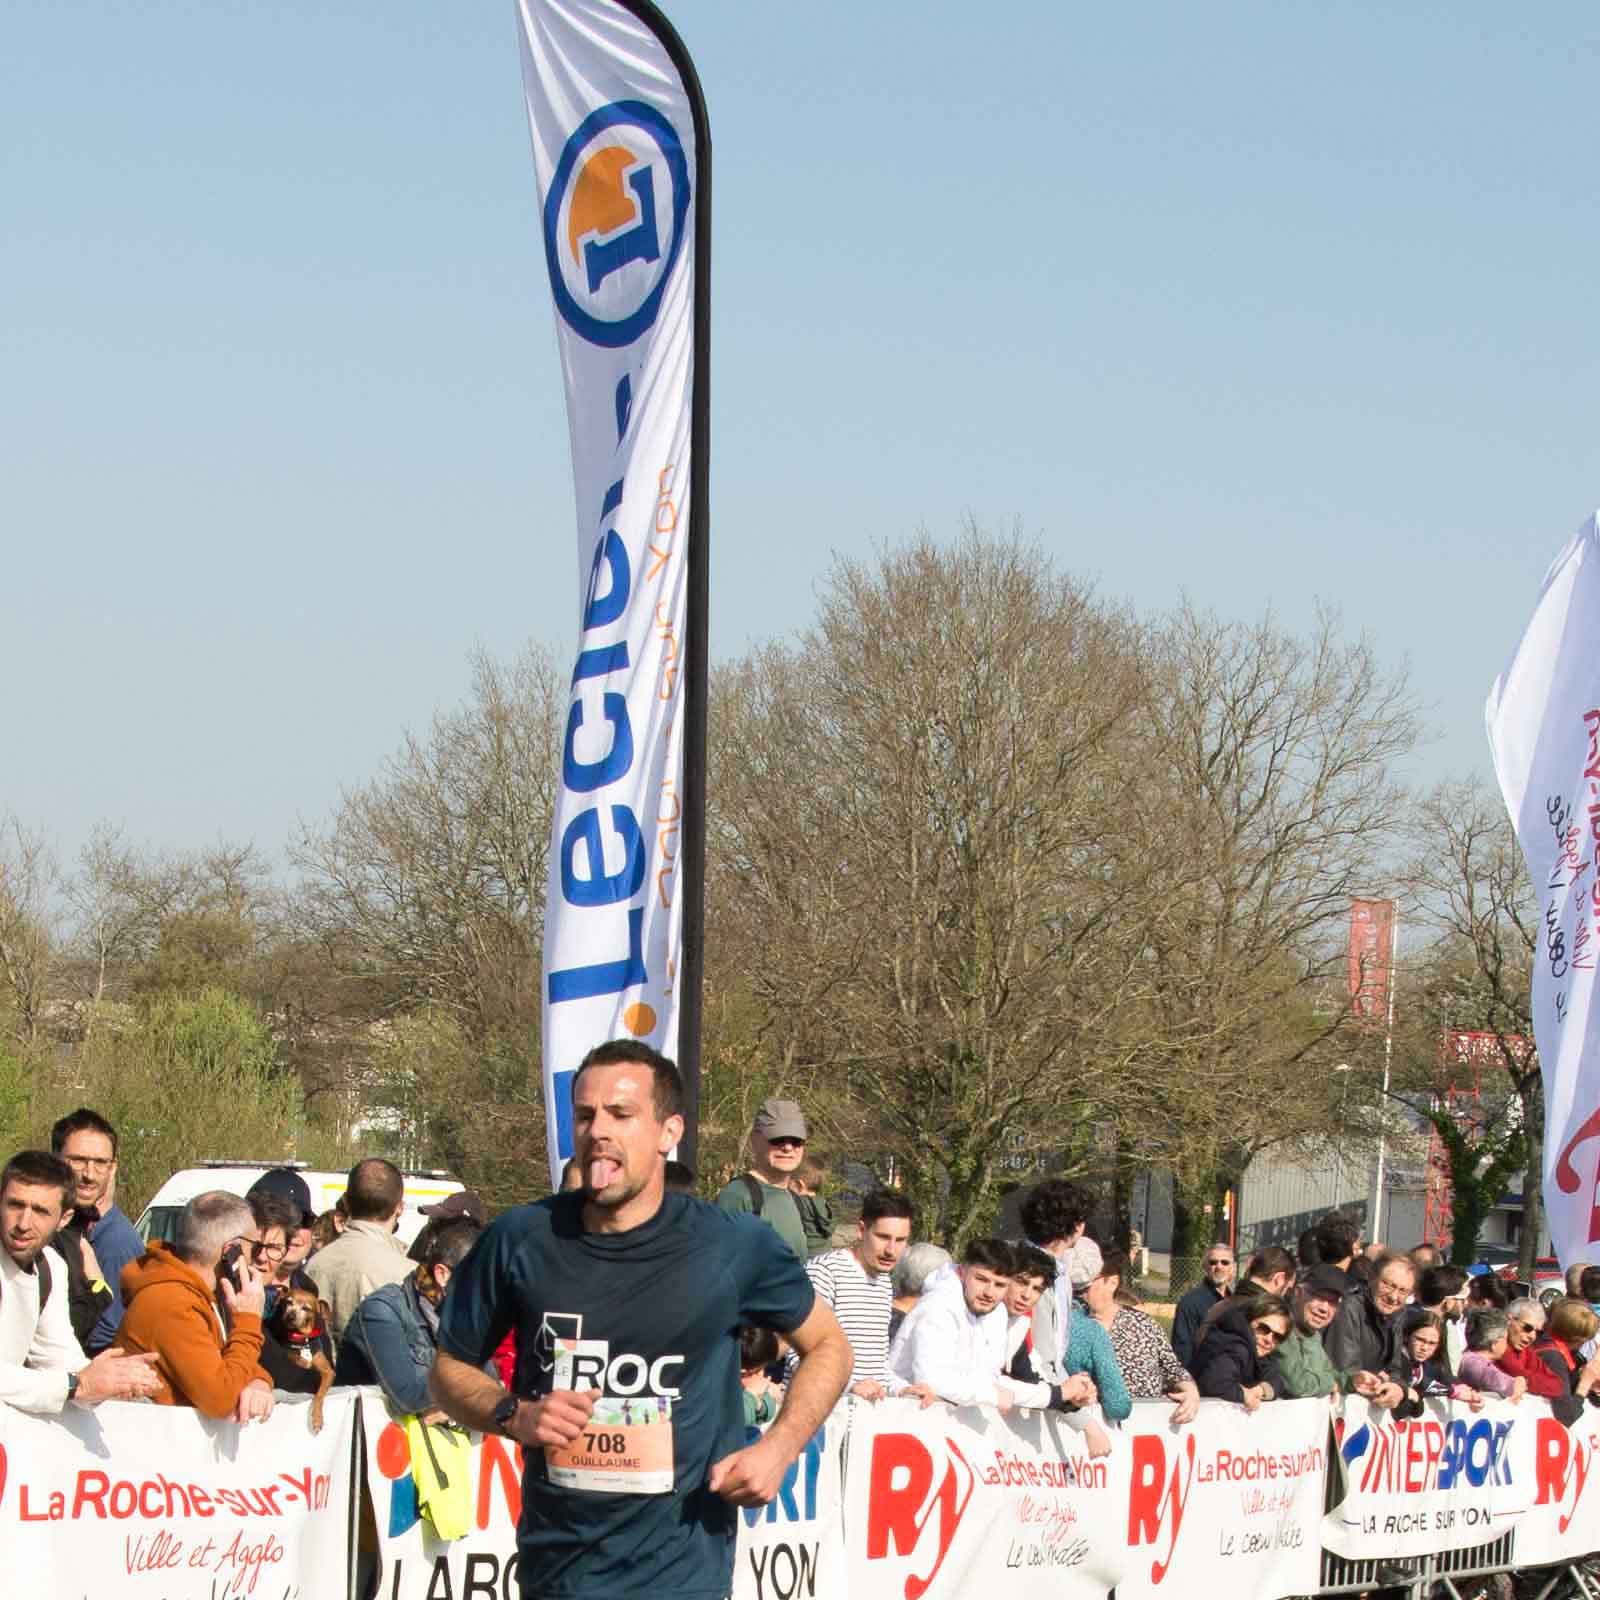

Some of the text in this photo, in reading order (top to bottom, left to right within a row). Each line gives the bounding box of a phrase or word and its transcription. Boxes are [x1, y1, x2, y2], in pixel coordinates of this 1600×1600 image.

[570, 1353, 685, 1397] ROC
[583, 1433, 626, 1454] 708
[571, 1455, 641, 1468] GUILLAUME
[19, 1467, 331, 1521] La Roche-sur-Yon
[1462, 1507, 1492, 1526] ON
[125, 1528, 284, 1594] Ville et Agglo
